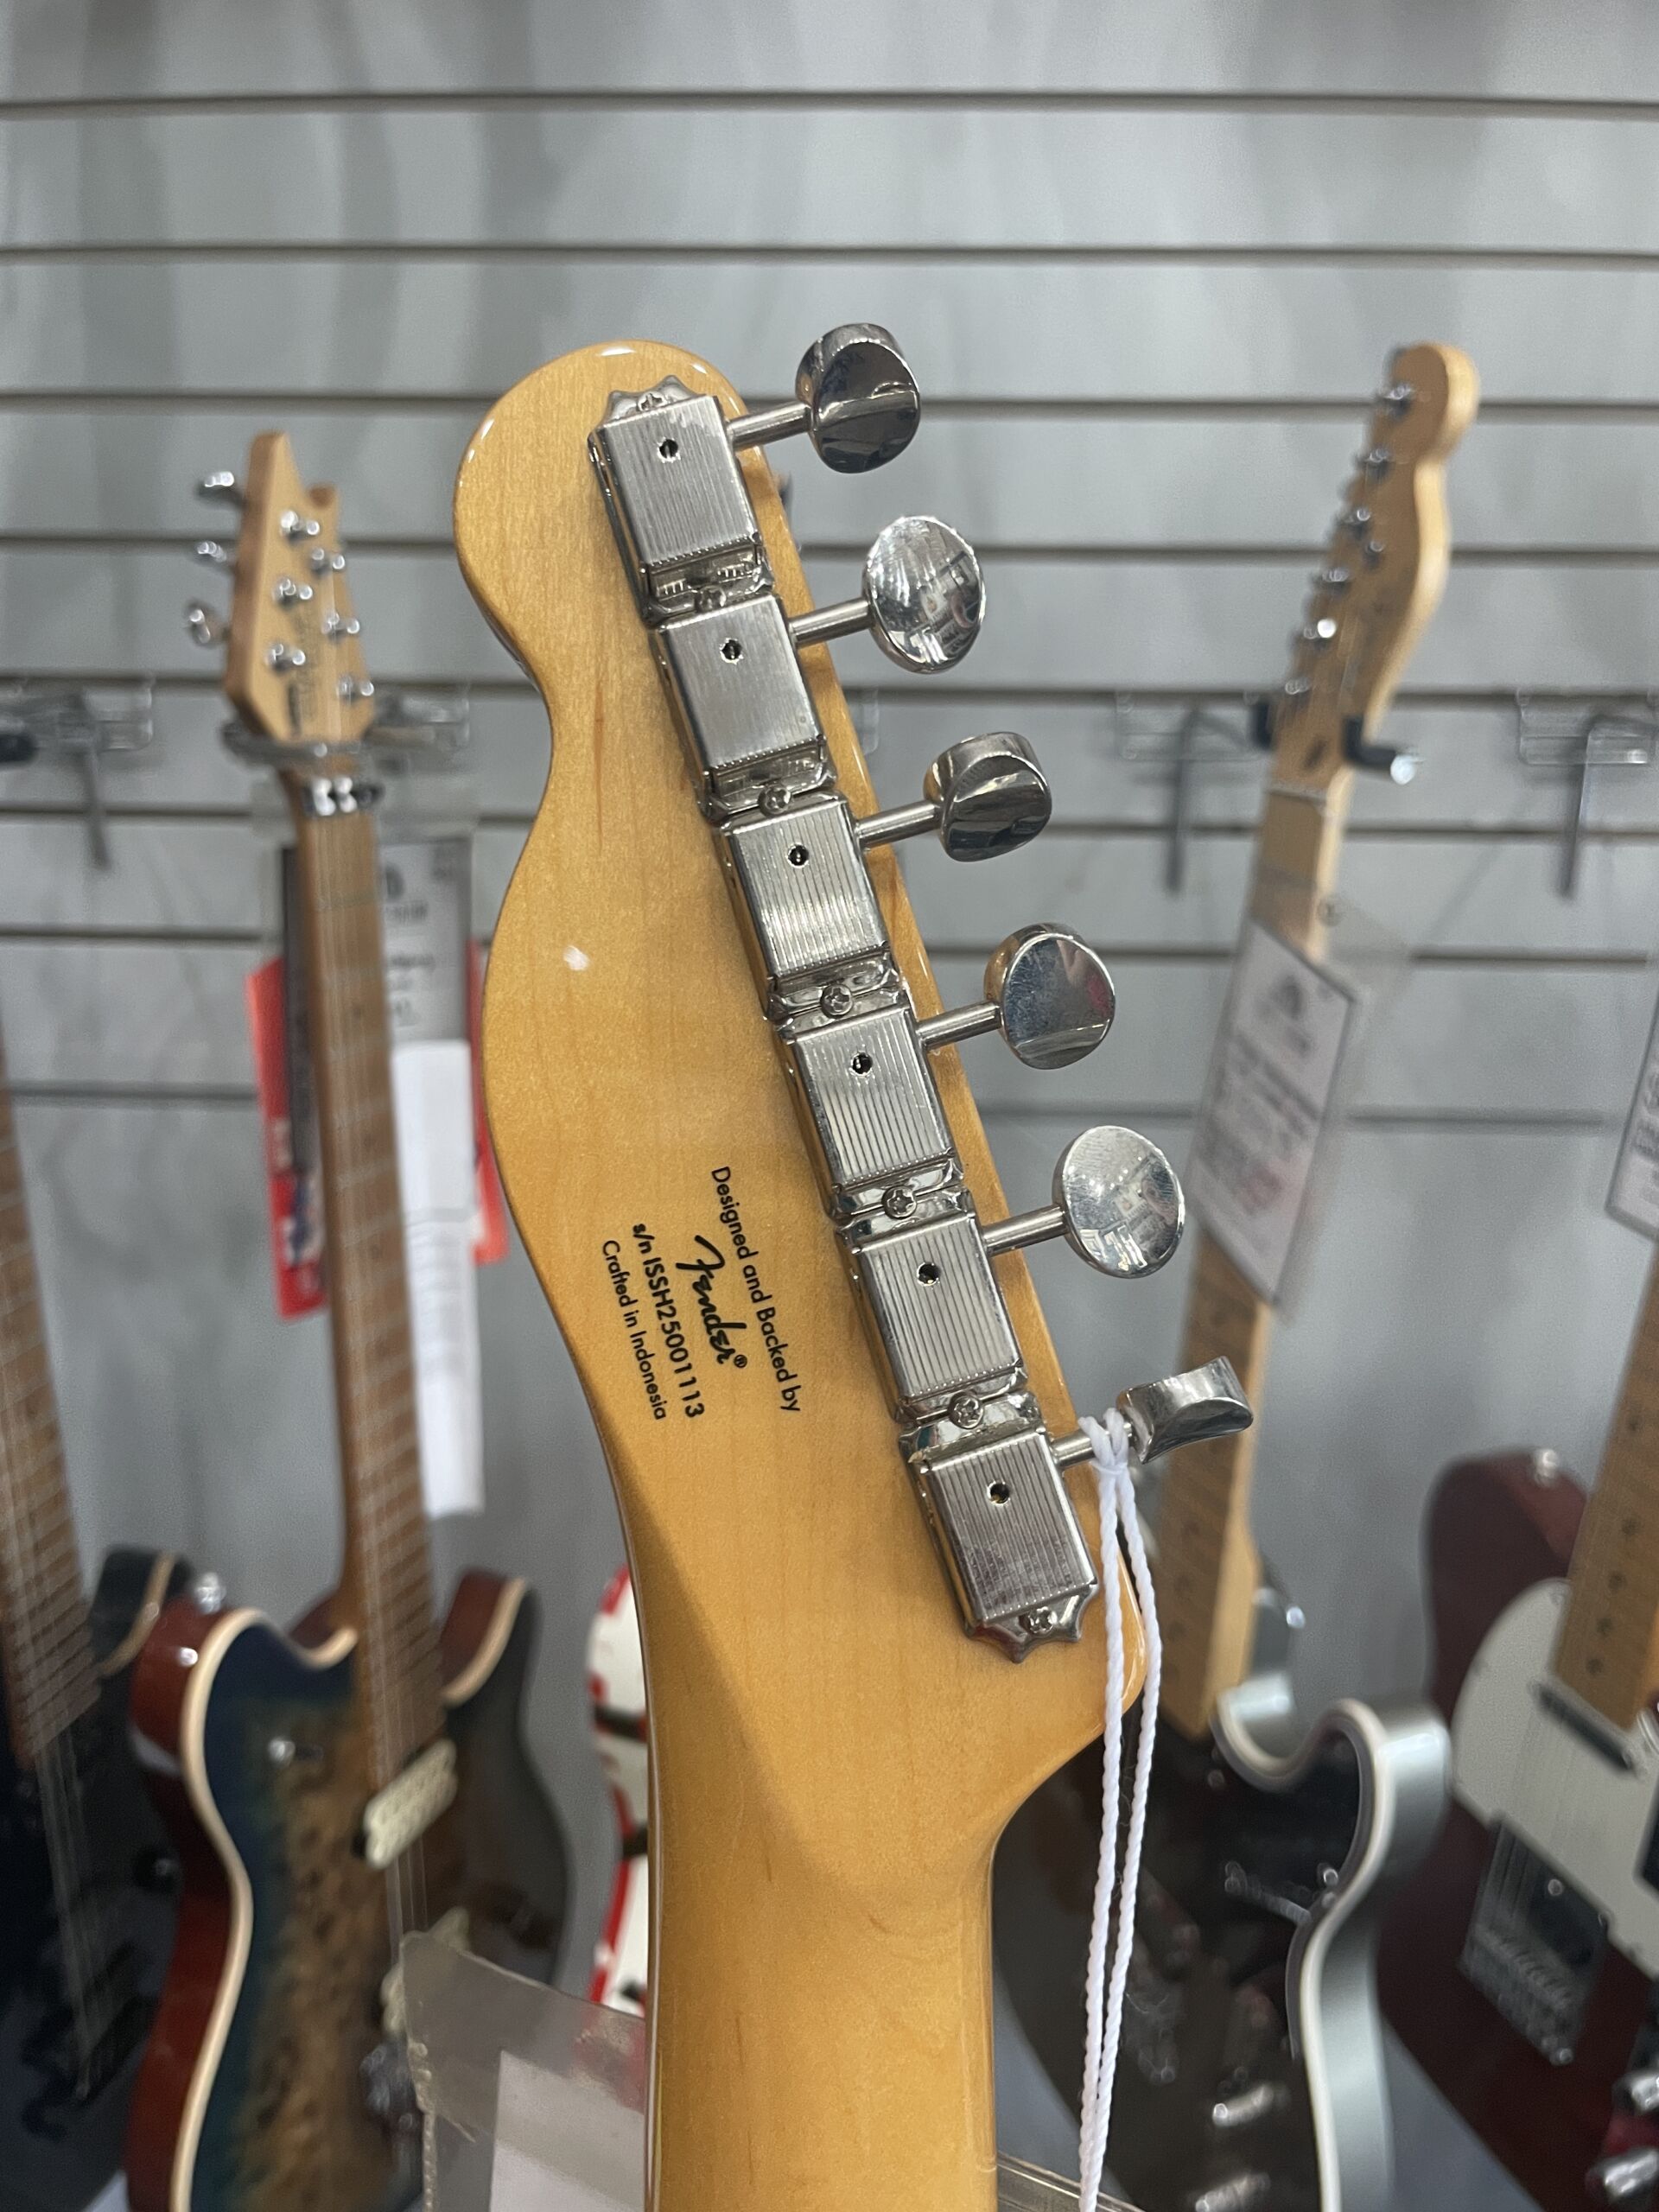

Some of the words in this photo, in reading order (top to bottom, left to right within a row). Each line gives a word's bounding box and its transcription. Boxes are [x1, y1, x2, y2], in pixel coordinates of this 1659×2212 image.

[632, 1223, 655, 1255] s/n
[711, 1166, 759, 1260] Designed
[602, 1239, 639, 1308] Crafted
[742, 1264, 772, 1304] and
[623, 1309, 640, 1328] in
[643, 1256, 705, 1418] ISSH25001113
[756, 1306, 798, 1382] Backed
[630, 1330, 668, 1421] Indonesia
[780, 1384, 802, 1412] by
